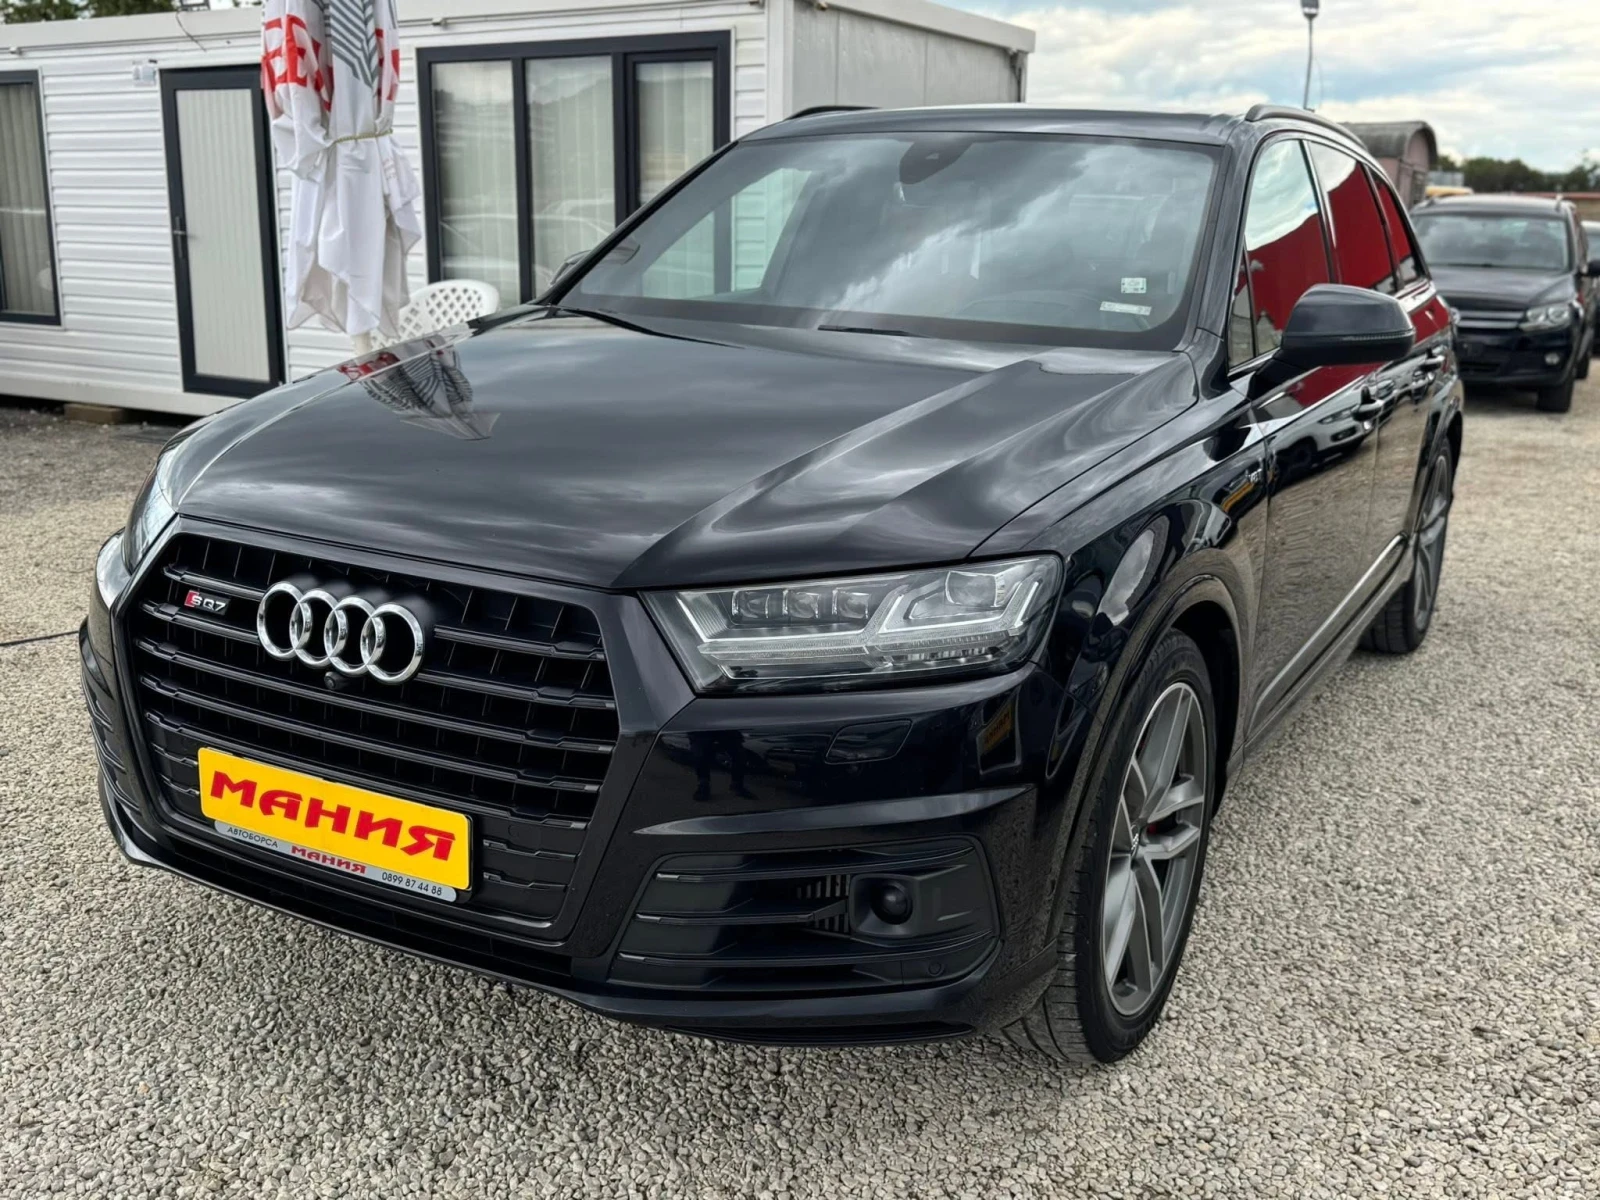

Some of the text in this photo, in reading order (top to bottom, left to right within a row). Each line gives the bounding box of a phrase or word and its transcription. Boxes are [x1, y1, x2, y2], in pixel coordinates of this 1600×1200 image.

[188, 593, 226, 611] SQ7
[210, 771, 456, 861] МАНИЯ
[227, 827, 366, 874] АВТОБОРСА МАНИЯ
[381, 872, 442, 896] 0899 87 44 88
